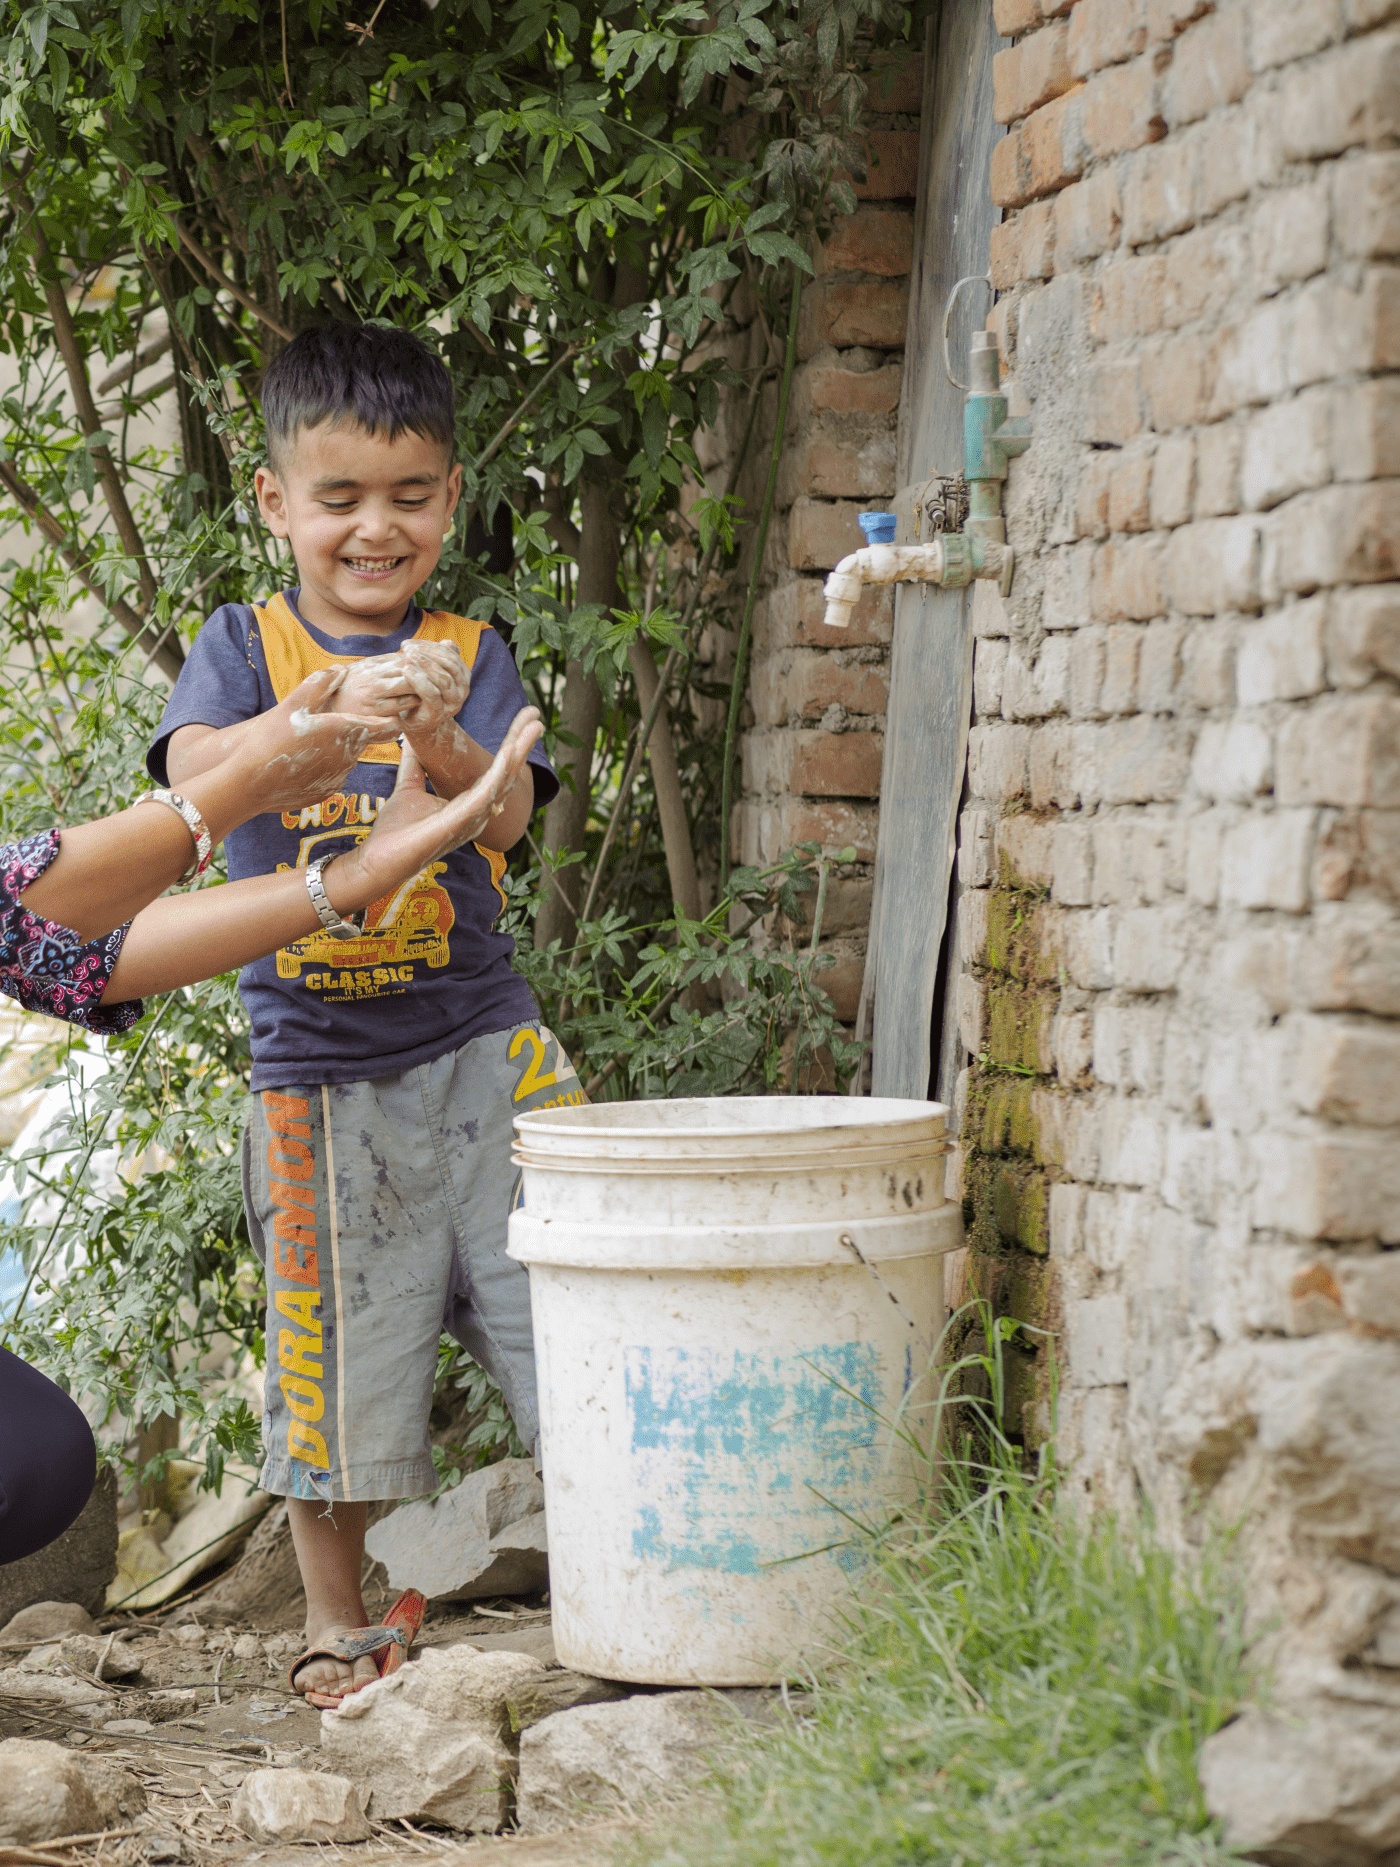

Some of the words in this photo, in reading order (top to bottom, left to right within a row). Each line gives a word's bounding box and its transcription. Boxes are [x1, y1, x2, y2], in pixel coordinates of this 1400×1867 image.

[305, 965, 414, 990] CLASSIC
[344, 986, 363, 996] IT'S
[364, 985, 380, 995] MY
[263, 1090, 330, 1471] DORAEMON
